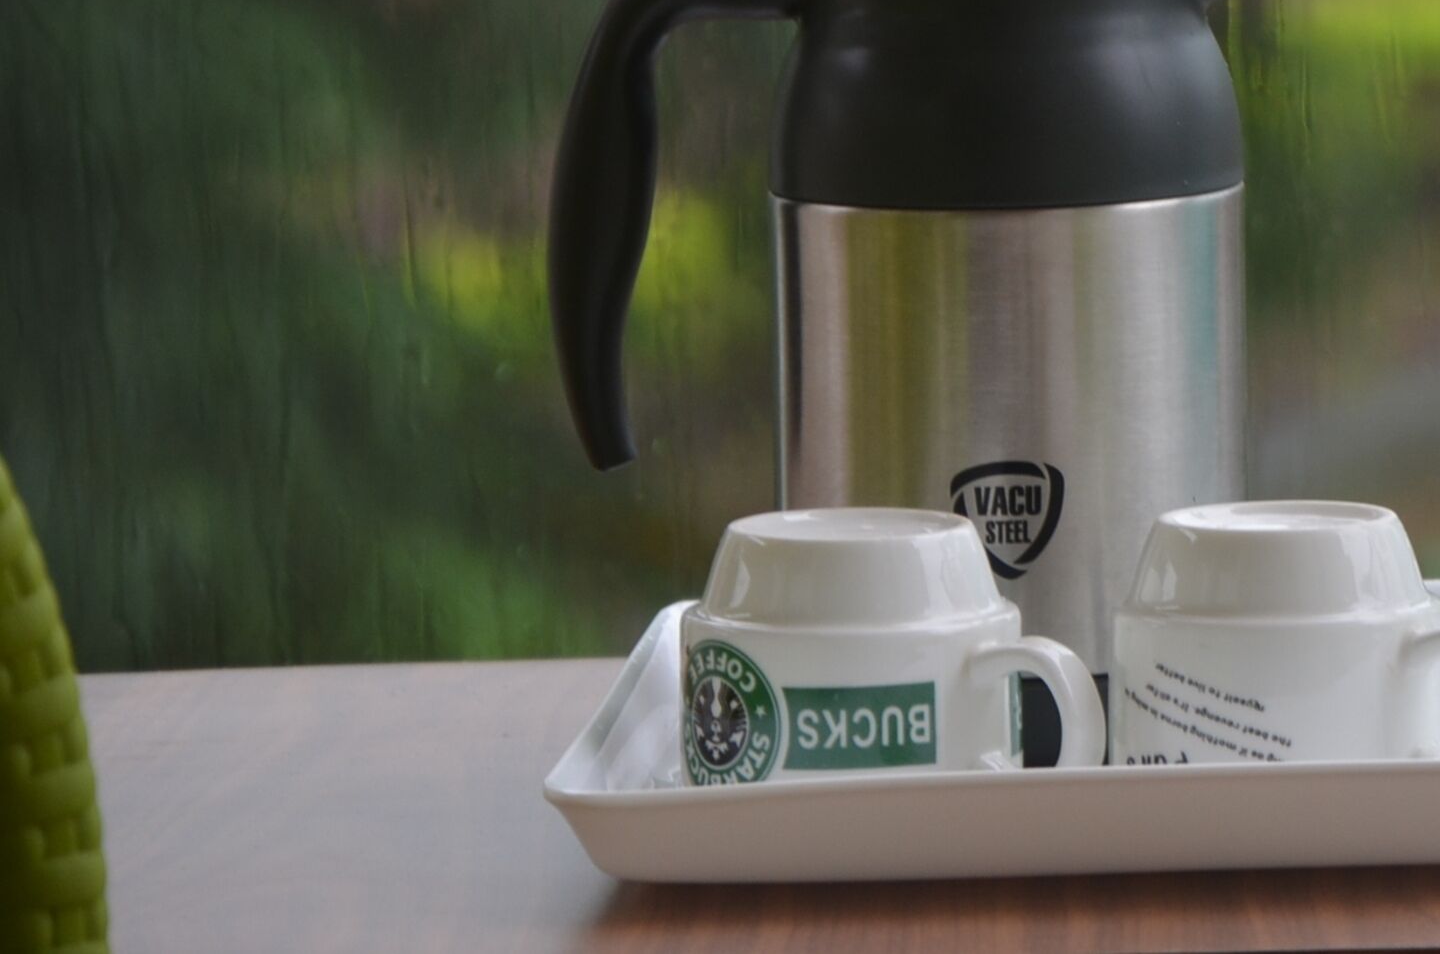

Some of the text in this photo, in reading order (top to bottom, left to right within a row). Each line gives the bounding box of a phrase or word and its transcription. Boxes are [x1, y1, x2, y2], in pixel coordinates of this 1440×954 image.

[974, 485, 1043, 517] VACU
[985, 519, 1032, 545] STEEL
[688, 648, 757, 693] COFFEE
[797, 703, 932, 749] BUCKS
